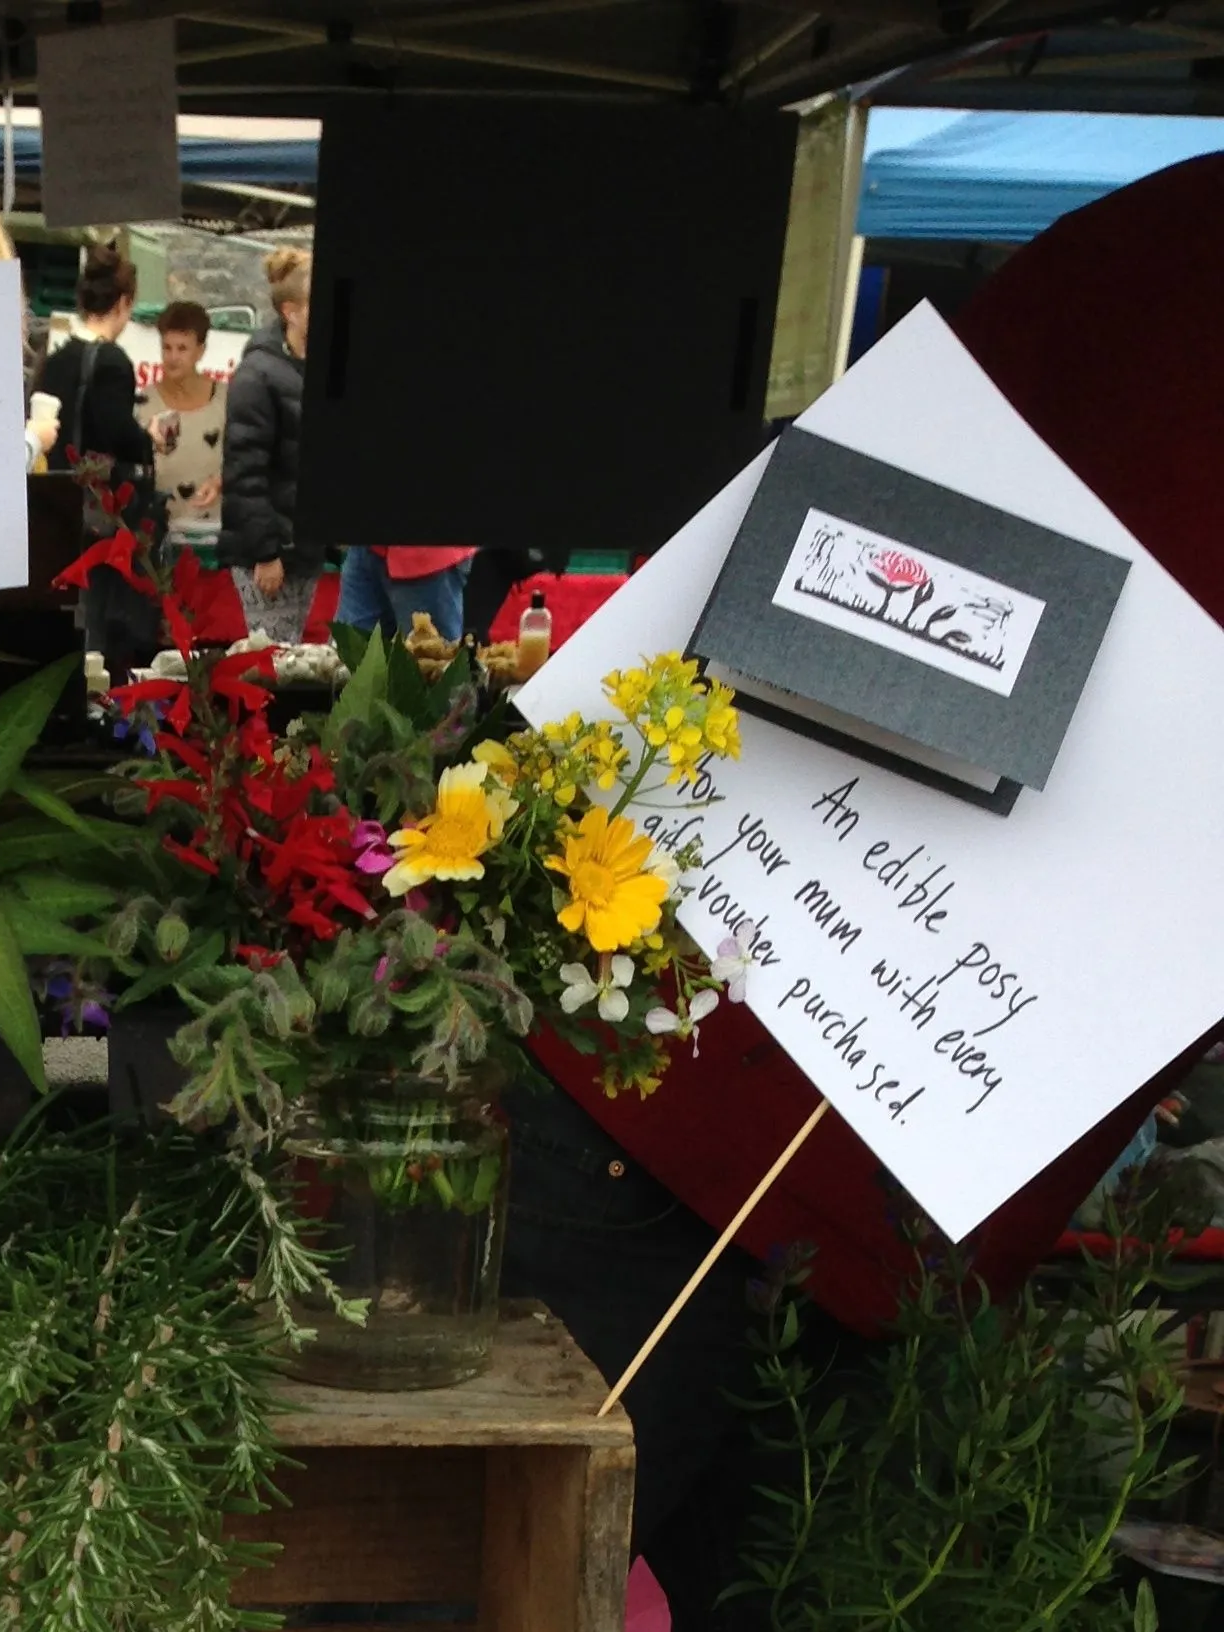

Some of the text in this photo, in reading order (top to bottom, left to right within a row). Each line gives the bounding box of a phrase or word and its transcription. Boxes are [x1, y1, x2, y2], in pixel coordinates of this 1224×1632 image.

[702, 812, 791, 876] your
[792, 876, 863, 956] mum
[870, 960, 937, 1031] with
[932, 1028, 1005, 1115] every
[810, 777, 1038, 1038] An edible posy
[777, 976, 926, 1126] purchased.
